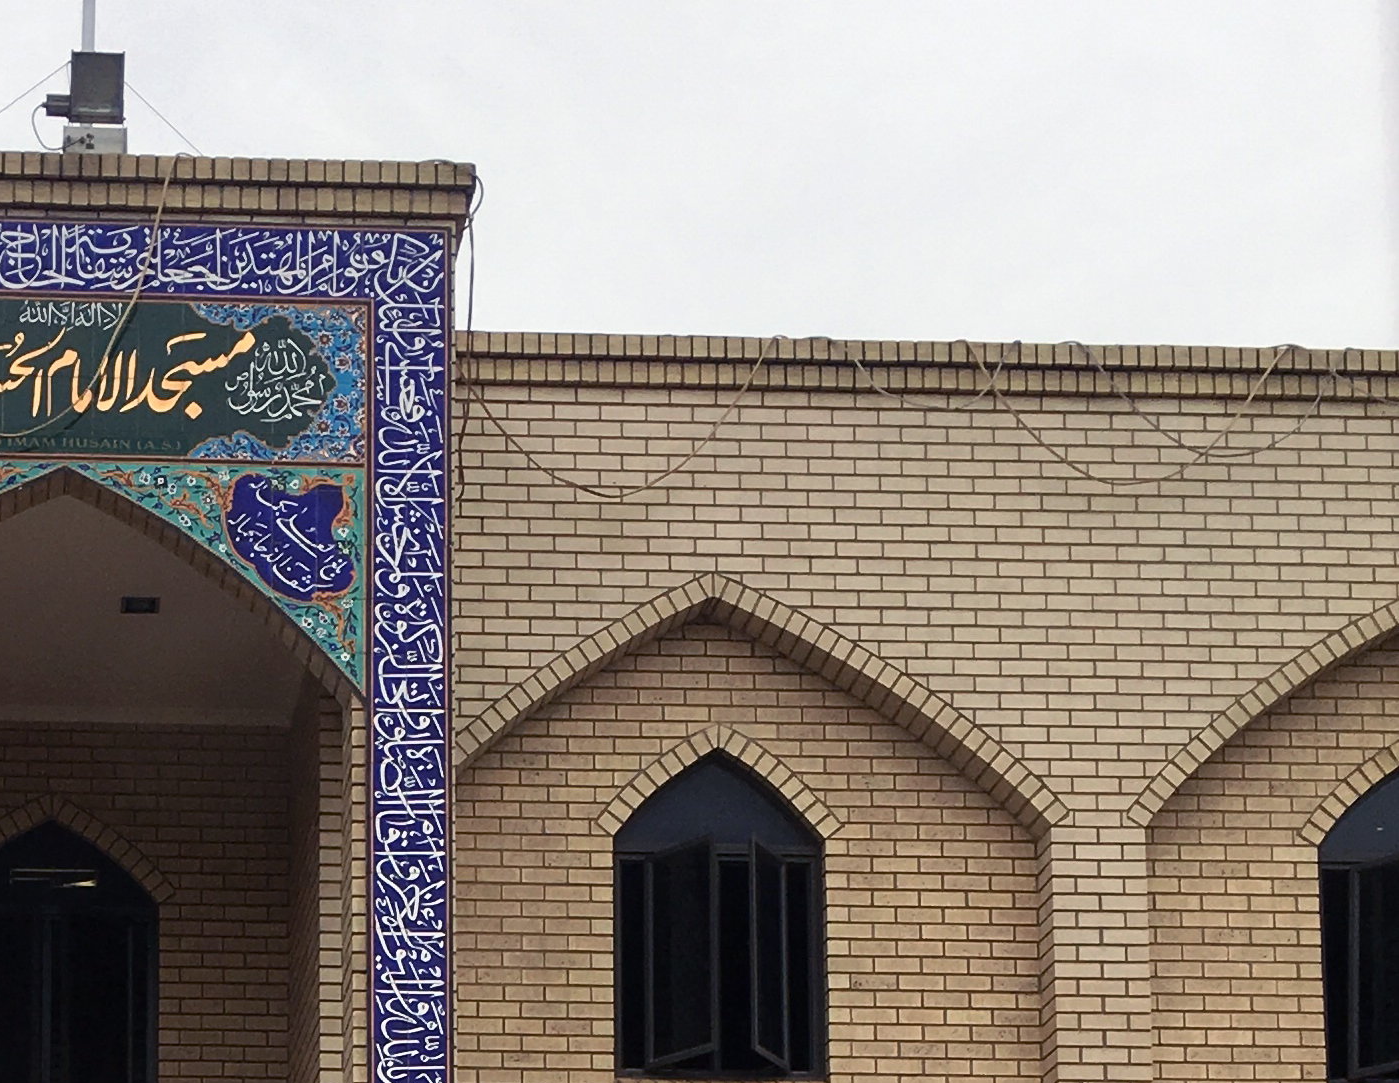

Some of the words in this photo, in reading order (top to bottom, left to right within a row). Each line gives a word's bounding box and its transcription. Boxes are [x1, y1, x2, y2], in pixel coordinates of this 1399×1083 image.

[119, 331, 256, 420] مسجد
[7, 437, 56, 447] IMAM
[63, 437, 130, 449] HUSAIN
